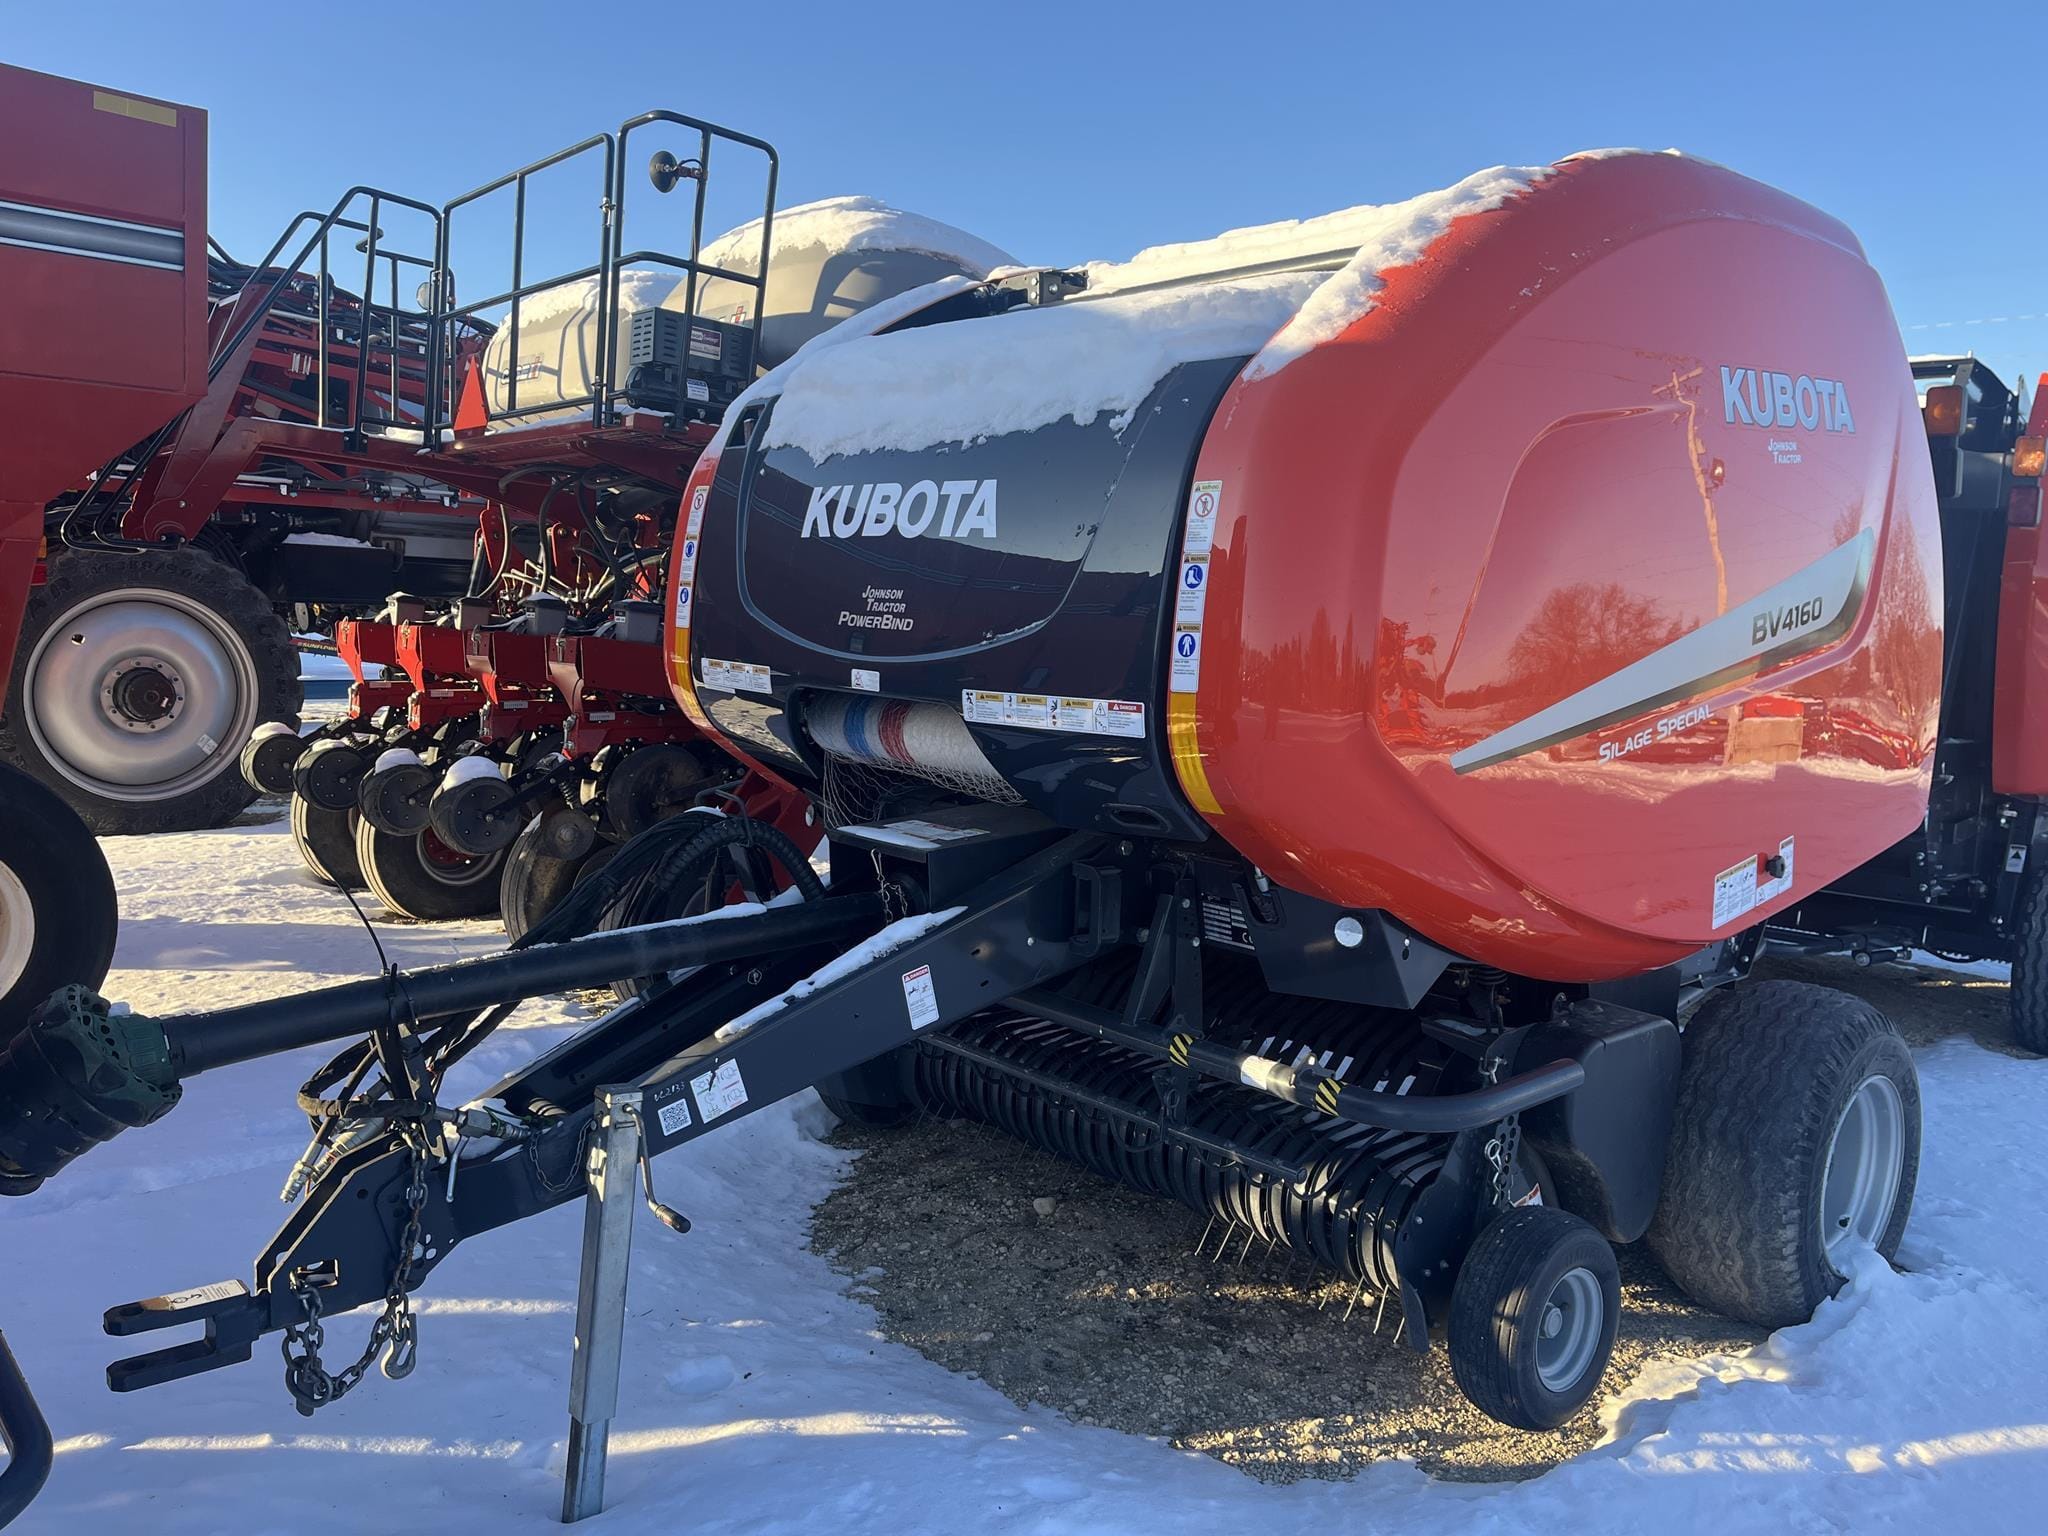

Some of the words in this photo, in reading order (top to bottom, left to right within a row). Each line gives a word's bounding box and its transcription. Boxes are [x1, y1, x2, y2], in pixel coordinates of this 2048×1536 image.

[1720, 365, 1856, 433] KUBOTA
[1768, 438, 1797, 451] JOHNSON
[1772, 451, 1802, 464] TRACTOR
[801, 479, 998, 539] KUBOTA
[862, 585, 904, 600] JOHNSON
[866, 600, 906, 613] TRACTOR
[1751, 597, 1823, 646] BV4160
[1598, 728, 1653, 765] SILAGE
[1656, 704, 1715, 741] SPECIAL
